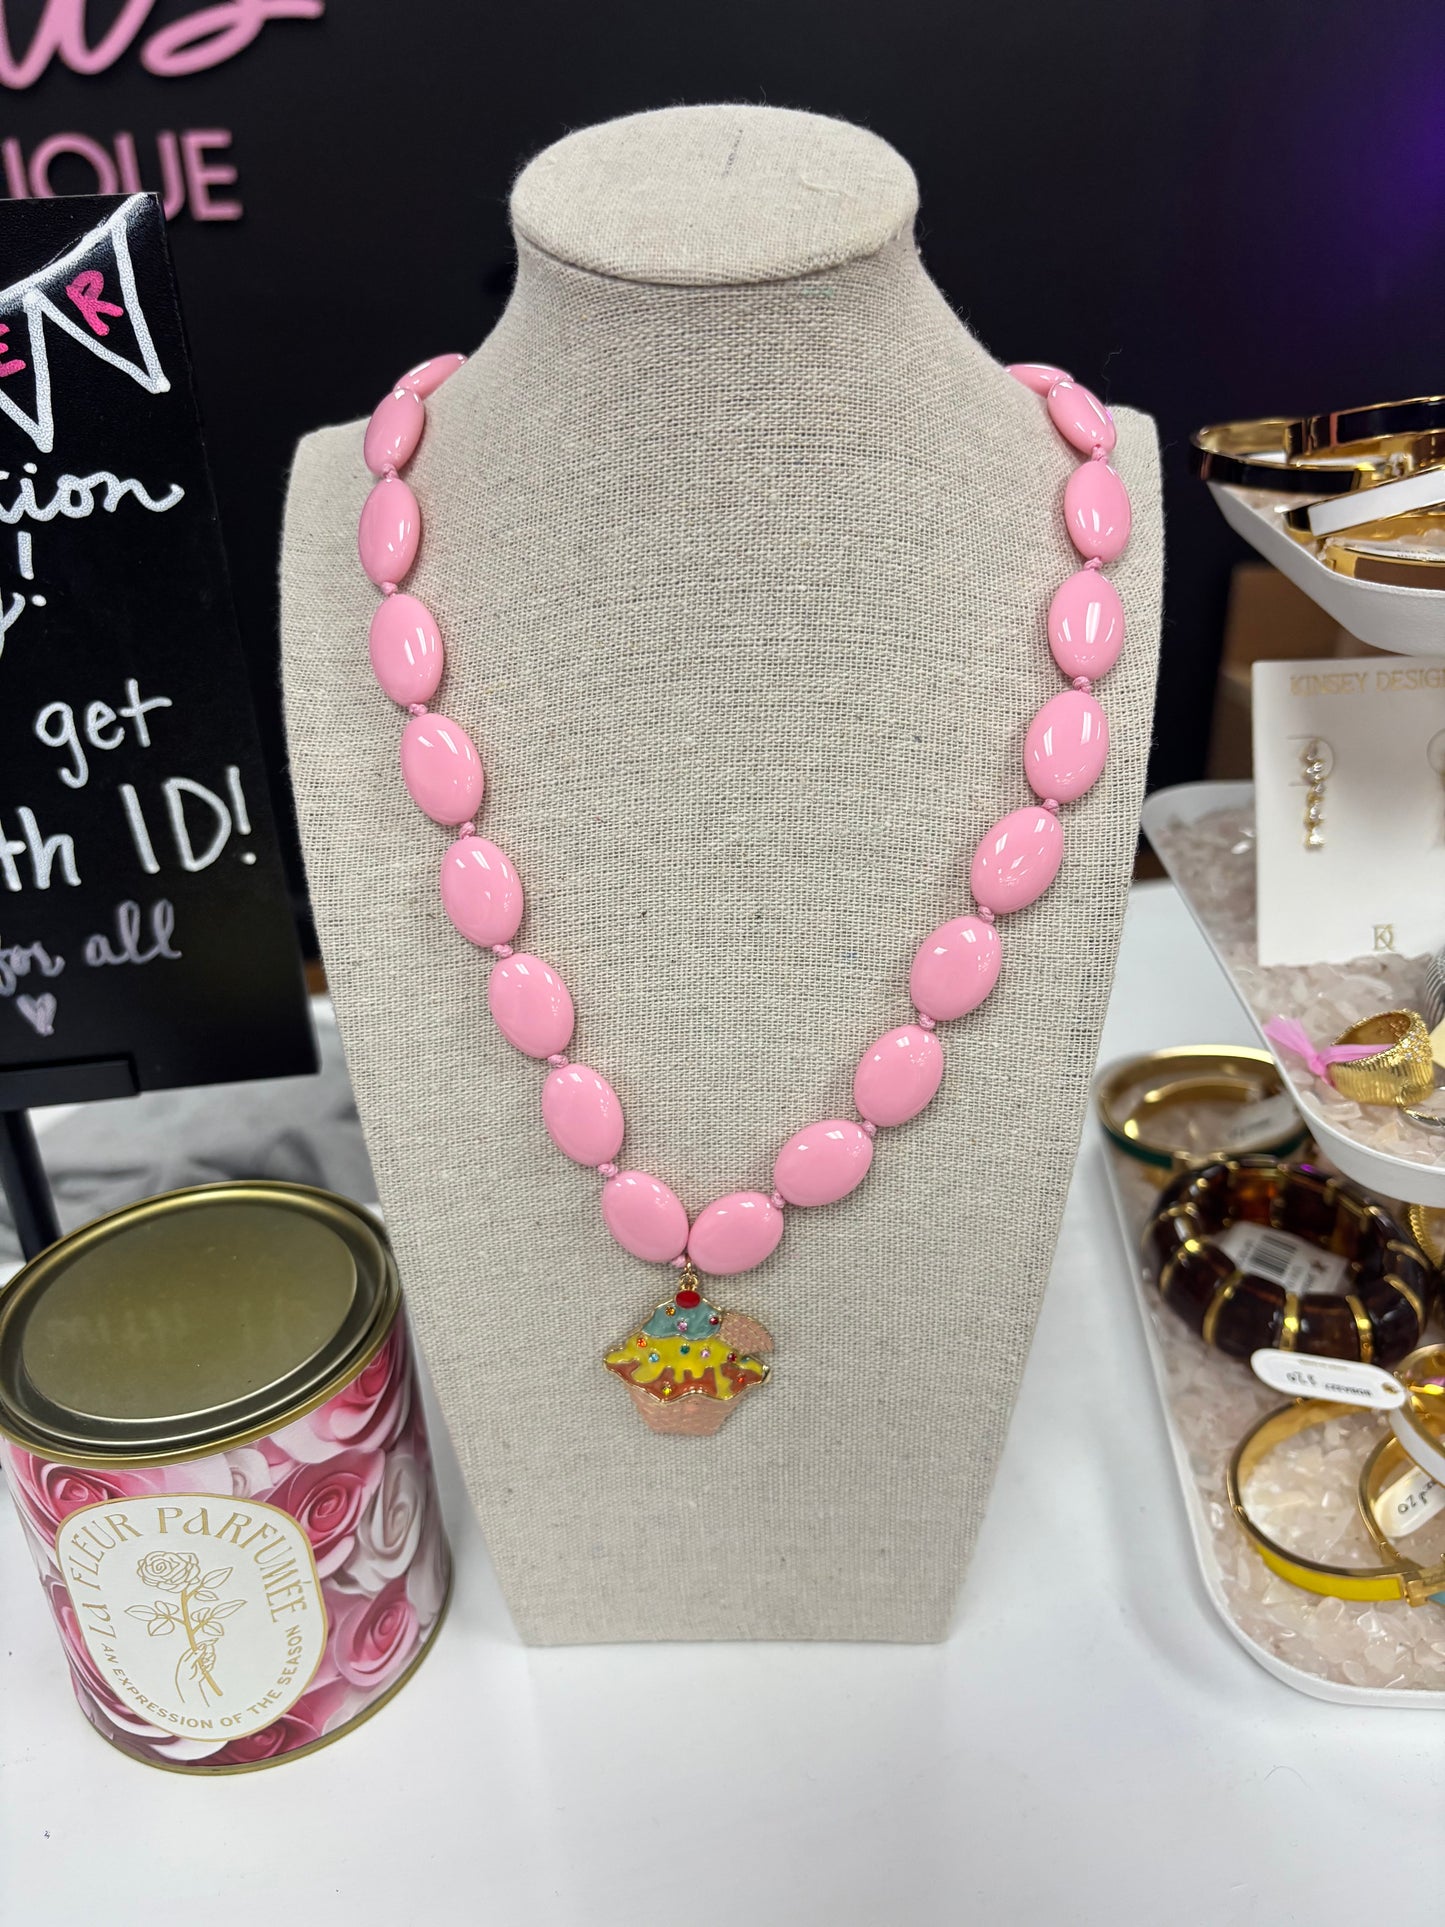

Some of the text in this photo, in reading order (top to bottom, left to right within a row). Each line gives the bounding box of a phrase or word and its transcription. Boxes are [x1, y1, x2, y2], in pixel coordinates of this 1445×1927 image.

[1290, 667, 1445, 697] KINSEY DESIG
[34, 678, 173, 789] get
[85, 899, 183, 967] all
[68, 1513, 143, 1591] FLEUR
[102, 1624, 303, 1729] AN EXPRESSION OF THE SEASON
